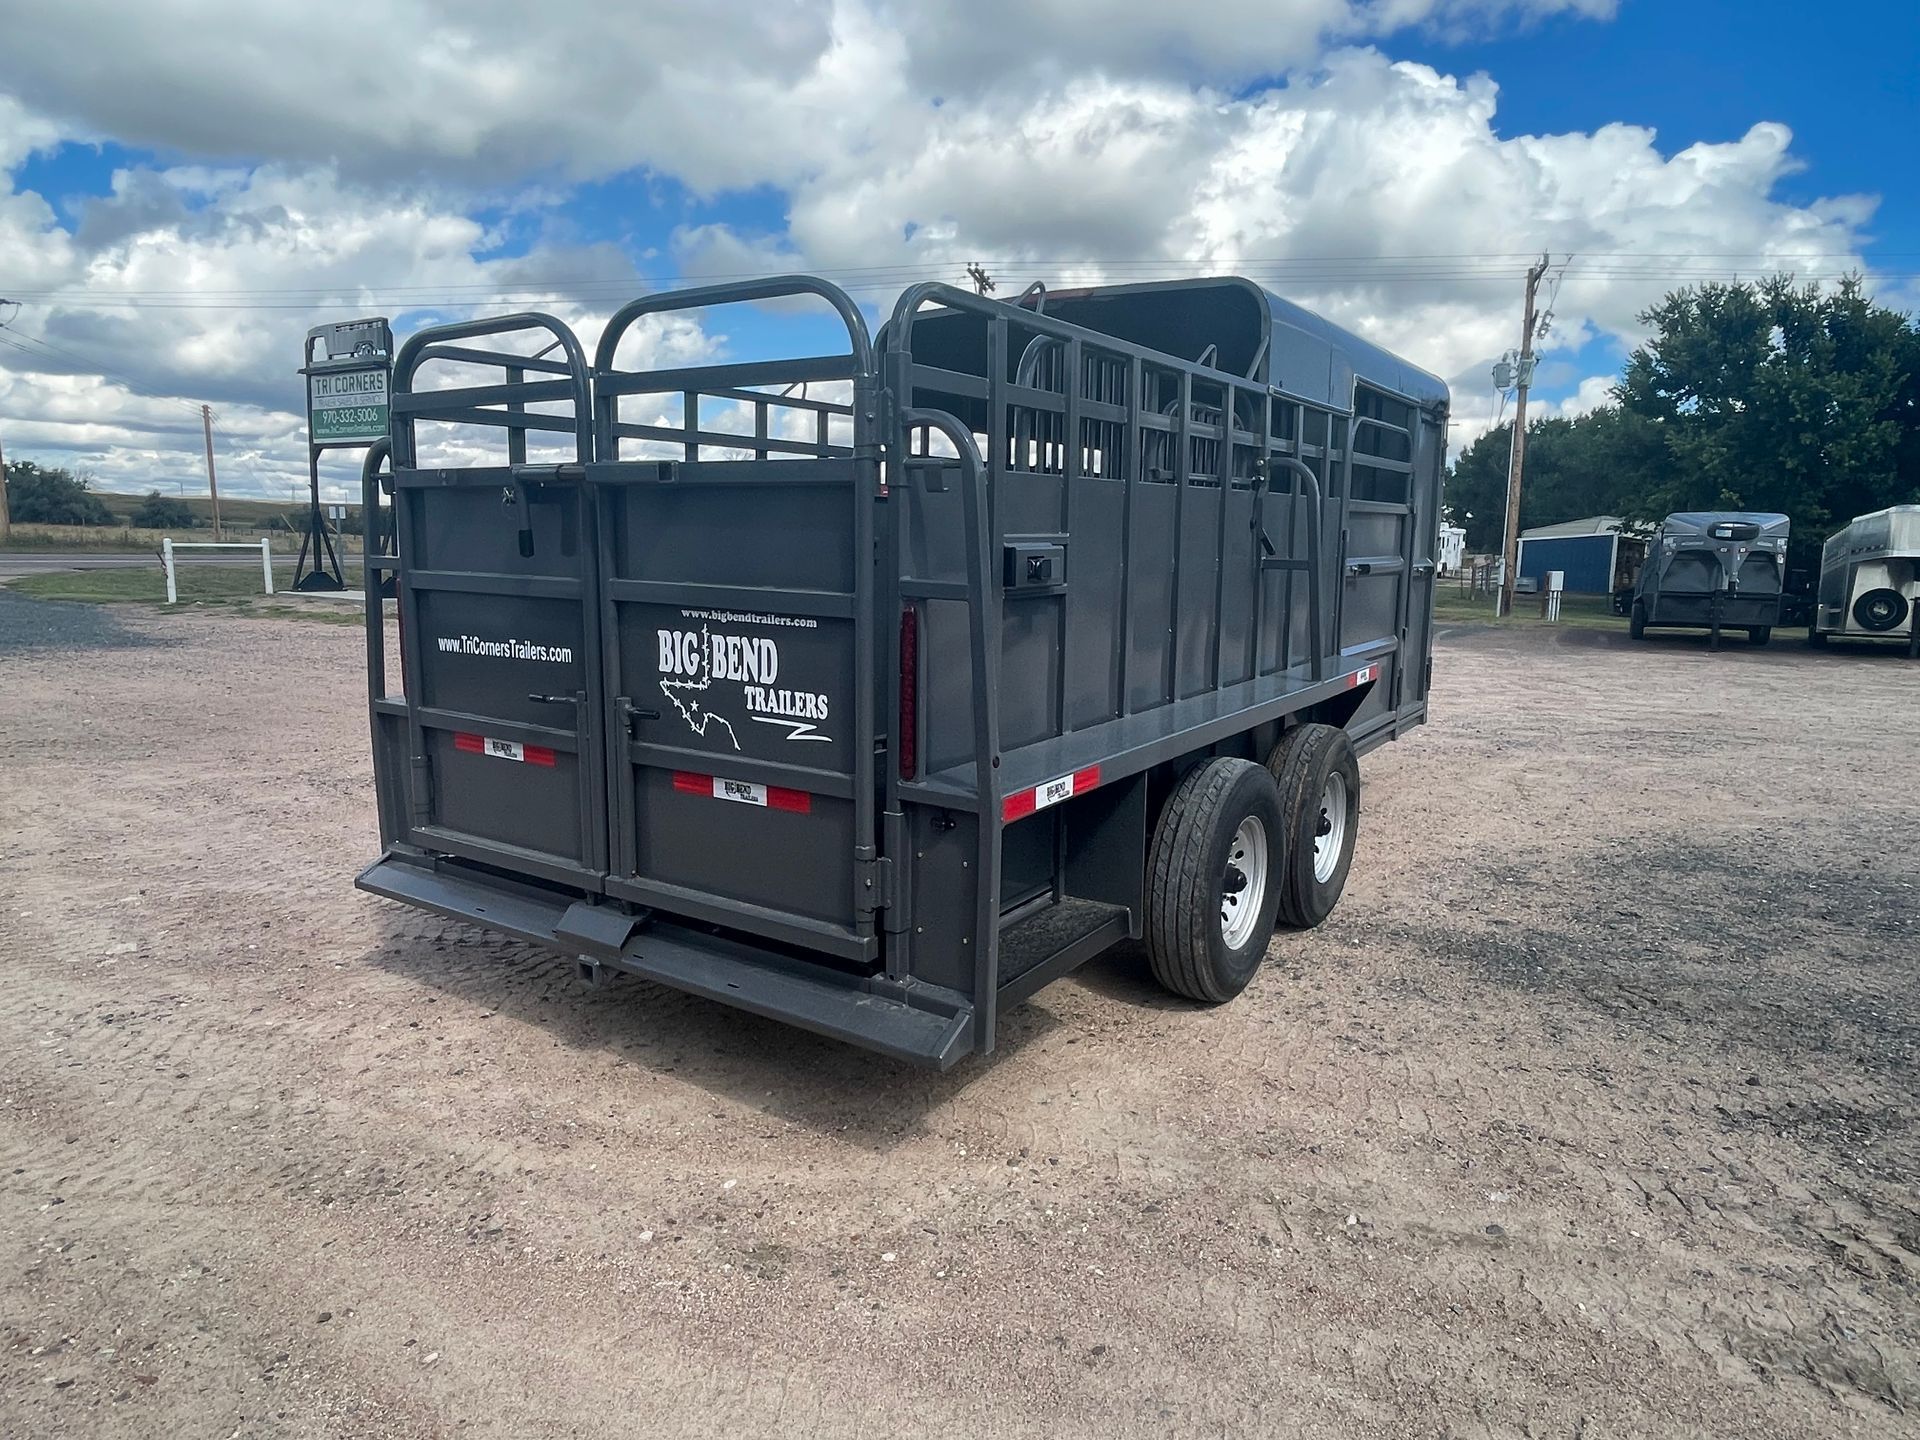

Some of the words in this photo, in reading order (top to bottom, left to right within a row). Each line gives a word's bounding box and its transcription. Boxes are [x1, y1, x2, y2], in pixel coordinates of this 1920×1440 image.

[316, 378, 332, 395] TRI
[335, 373, 383, 393] CORNERS
[322, 408, 378, 424] 970-332-5006
[681, 609, 818, 628] www.bigbendtrailers.com
[438, 635, 572, 663] www.TriCornersTrailers.com
[657, 629, 700, 676] BIG
[711, 634, 778, 685] BEND
[744, 686, 828, 720] TRAILERS
